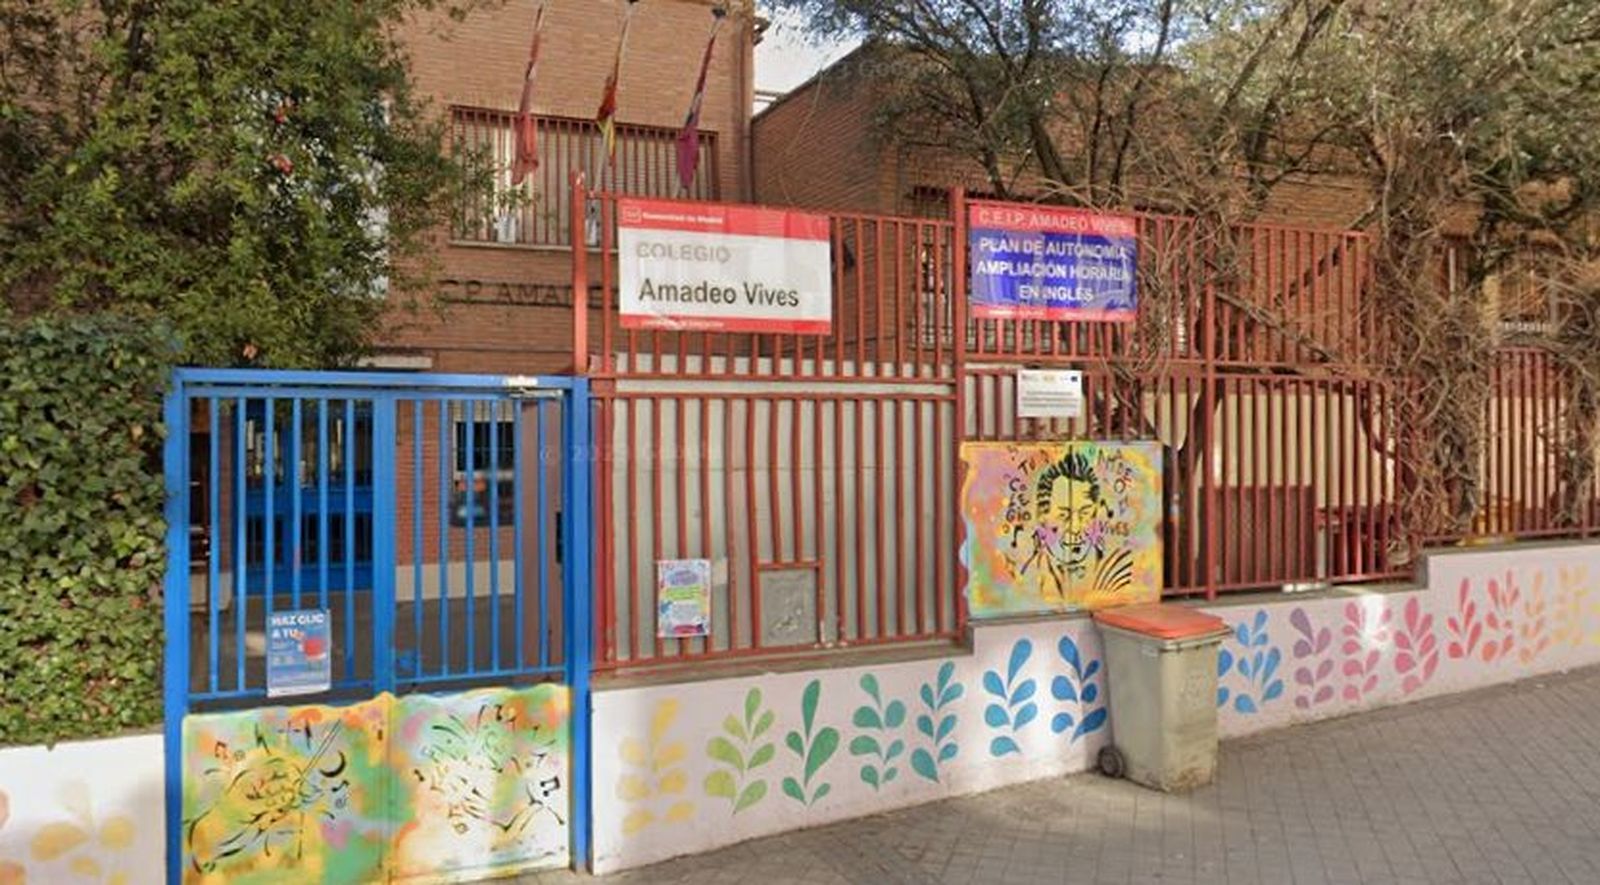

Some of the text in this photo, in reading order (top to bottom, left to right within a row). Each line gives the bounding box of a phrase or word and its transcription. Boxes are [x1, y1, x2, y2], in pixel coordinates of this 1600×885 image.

[1028, 213, 1089, 231] AMADEO
[636, 241, 732, 264] COLEGIO
[980, 237, 1020, 254] PLAN
[1023, 239, 1044, 255] DE
[1069, 264, 1131, 282] HORARIA
[638, 278, 800, 307] Amadeo Vives
[1019, 284, 1040, 300] EN
